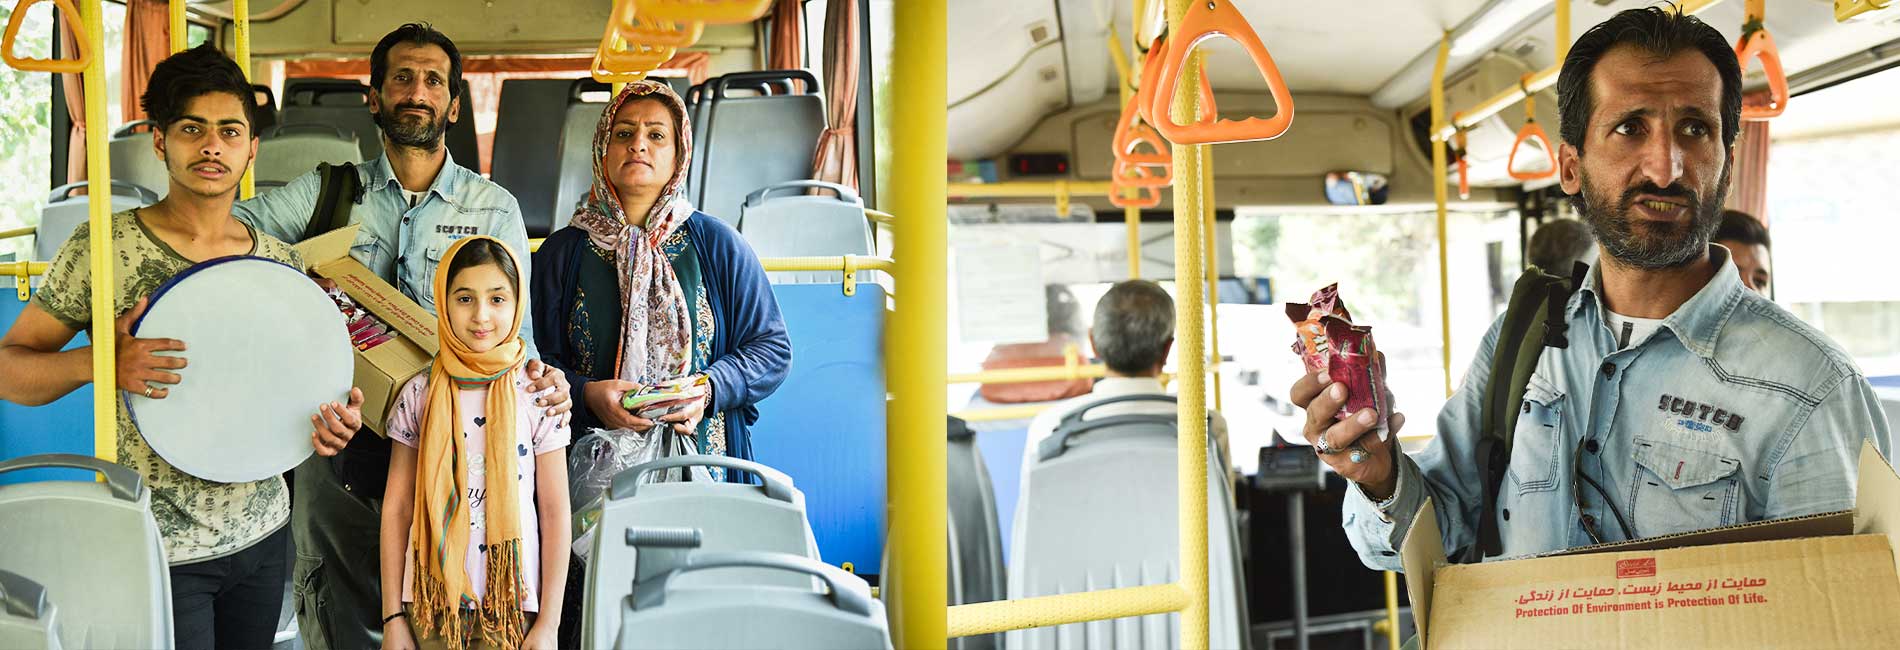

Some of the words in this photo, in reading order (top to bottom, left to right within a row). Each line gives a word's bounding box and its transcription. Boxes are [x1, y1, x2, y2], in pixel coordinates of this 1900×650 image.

[1666, 581, 1702, 594] محیط
[1705, 578, 1718, 592] از
[1721, 577, 1767, 591] حمایت
[1558, 589, 1570, 601] از
[1572, 587, 1615, 600] حمایت
[1515, 605, 1569, 618] Protection
[1572, 603, 1584, 614] Of
[1586, 600, 1652, 613] Environment
[1655, 599, 1664, 609] is
[1667, 596, 1724, 608] Protection
[1728, 594, 1740, 605] Of
[1743, 592, 1768, 604] Life.
